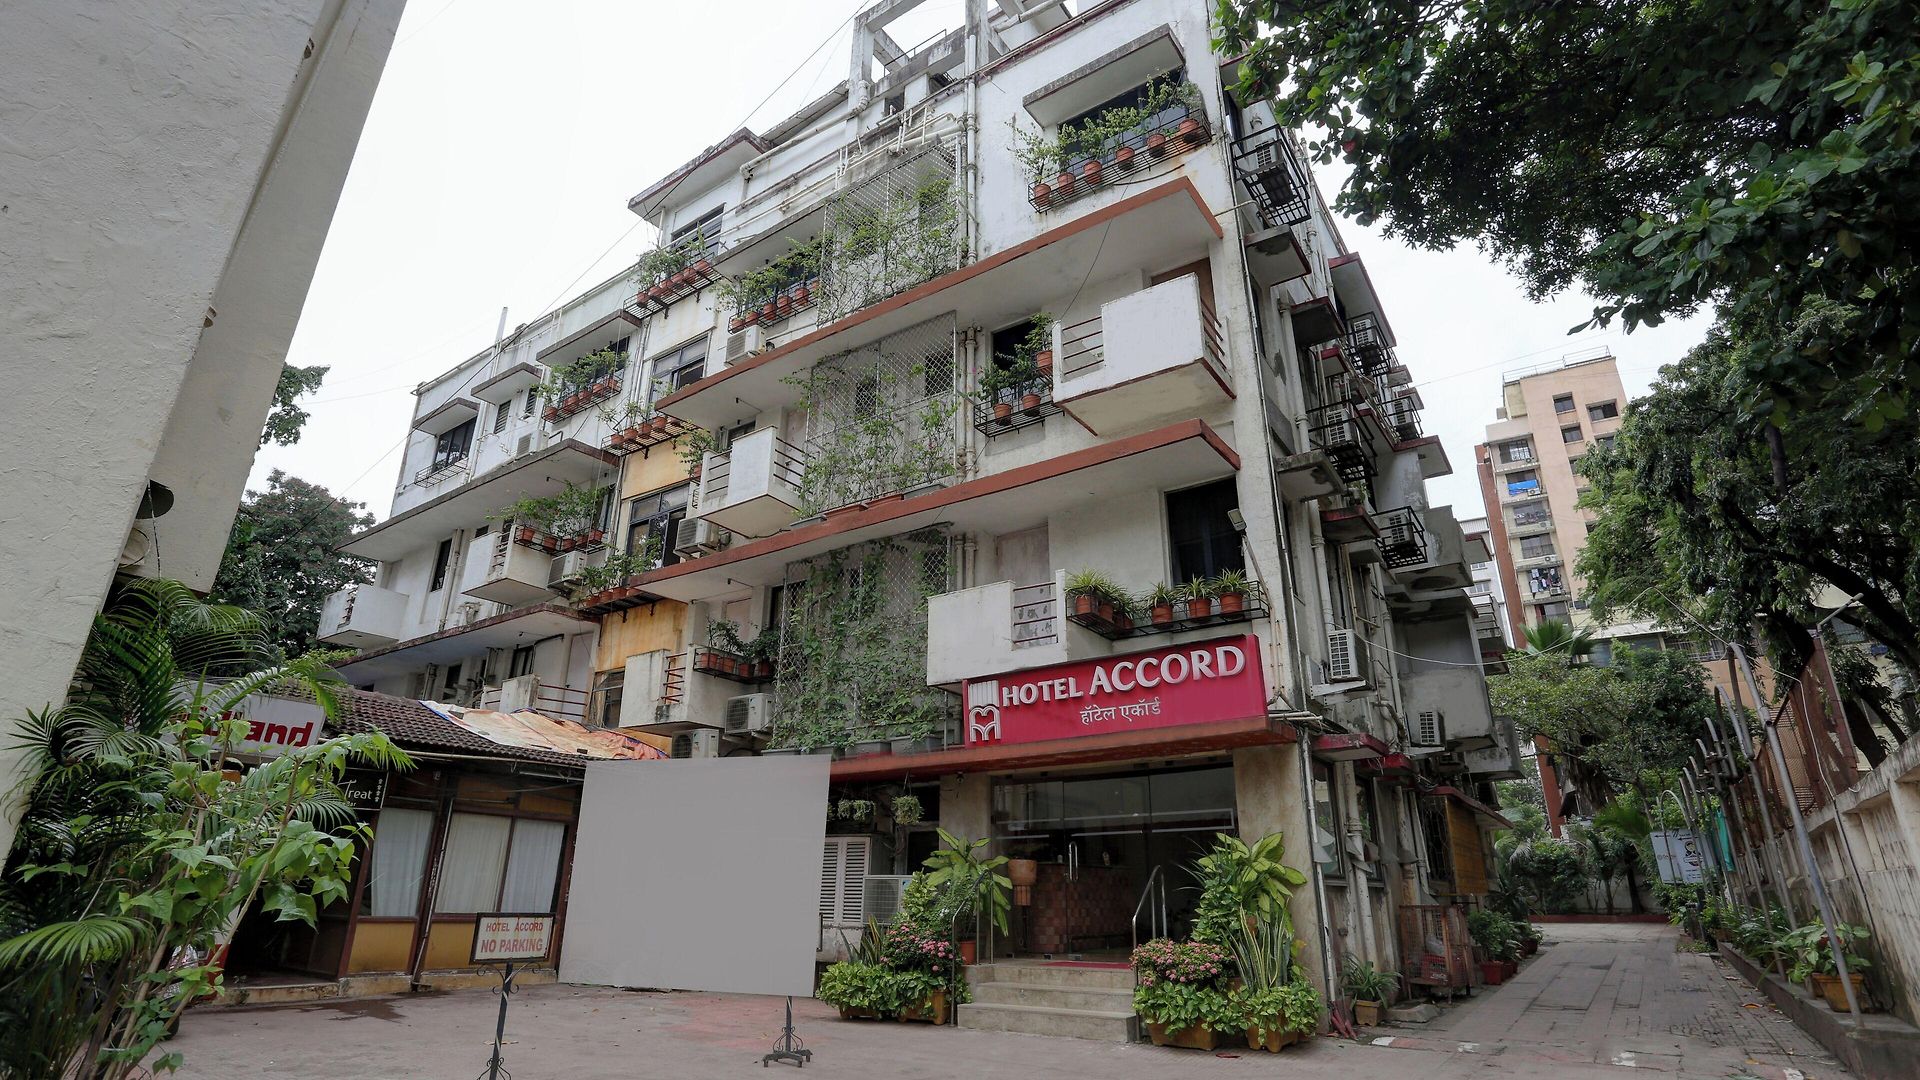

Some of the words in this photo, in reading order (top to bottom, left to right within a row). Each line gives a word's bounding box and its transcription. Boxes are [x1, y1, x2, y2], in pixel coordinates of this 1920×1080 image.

[1002, 677, 1084, 707] HOTEL
[1089, 645, 1246, 696] ACCORD
[1080, 704, 1117, 725] हॉटेल
[1118, 696, 1161, 722] एकॉर्ड
[336, 779, 373, 800] Treat
[486, 922, 510, 932] HOTEL
[515, 921, 544, 932] ACCORD
[481, 939, 497, 953] NO
[499, 938, 543, 953] PARKING
